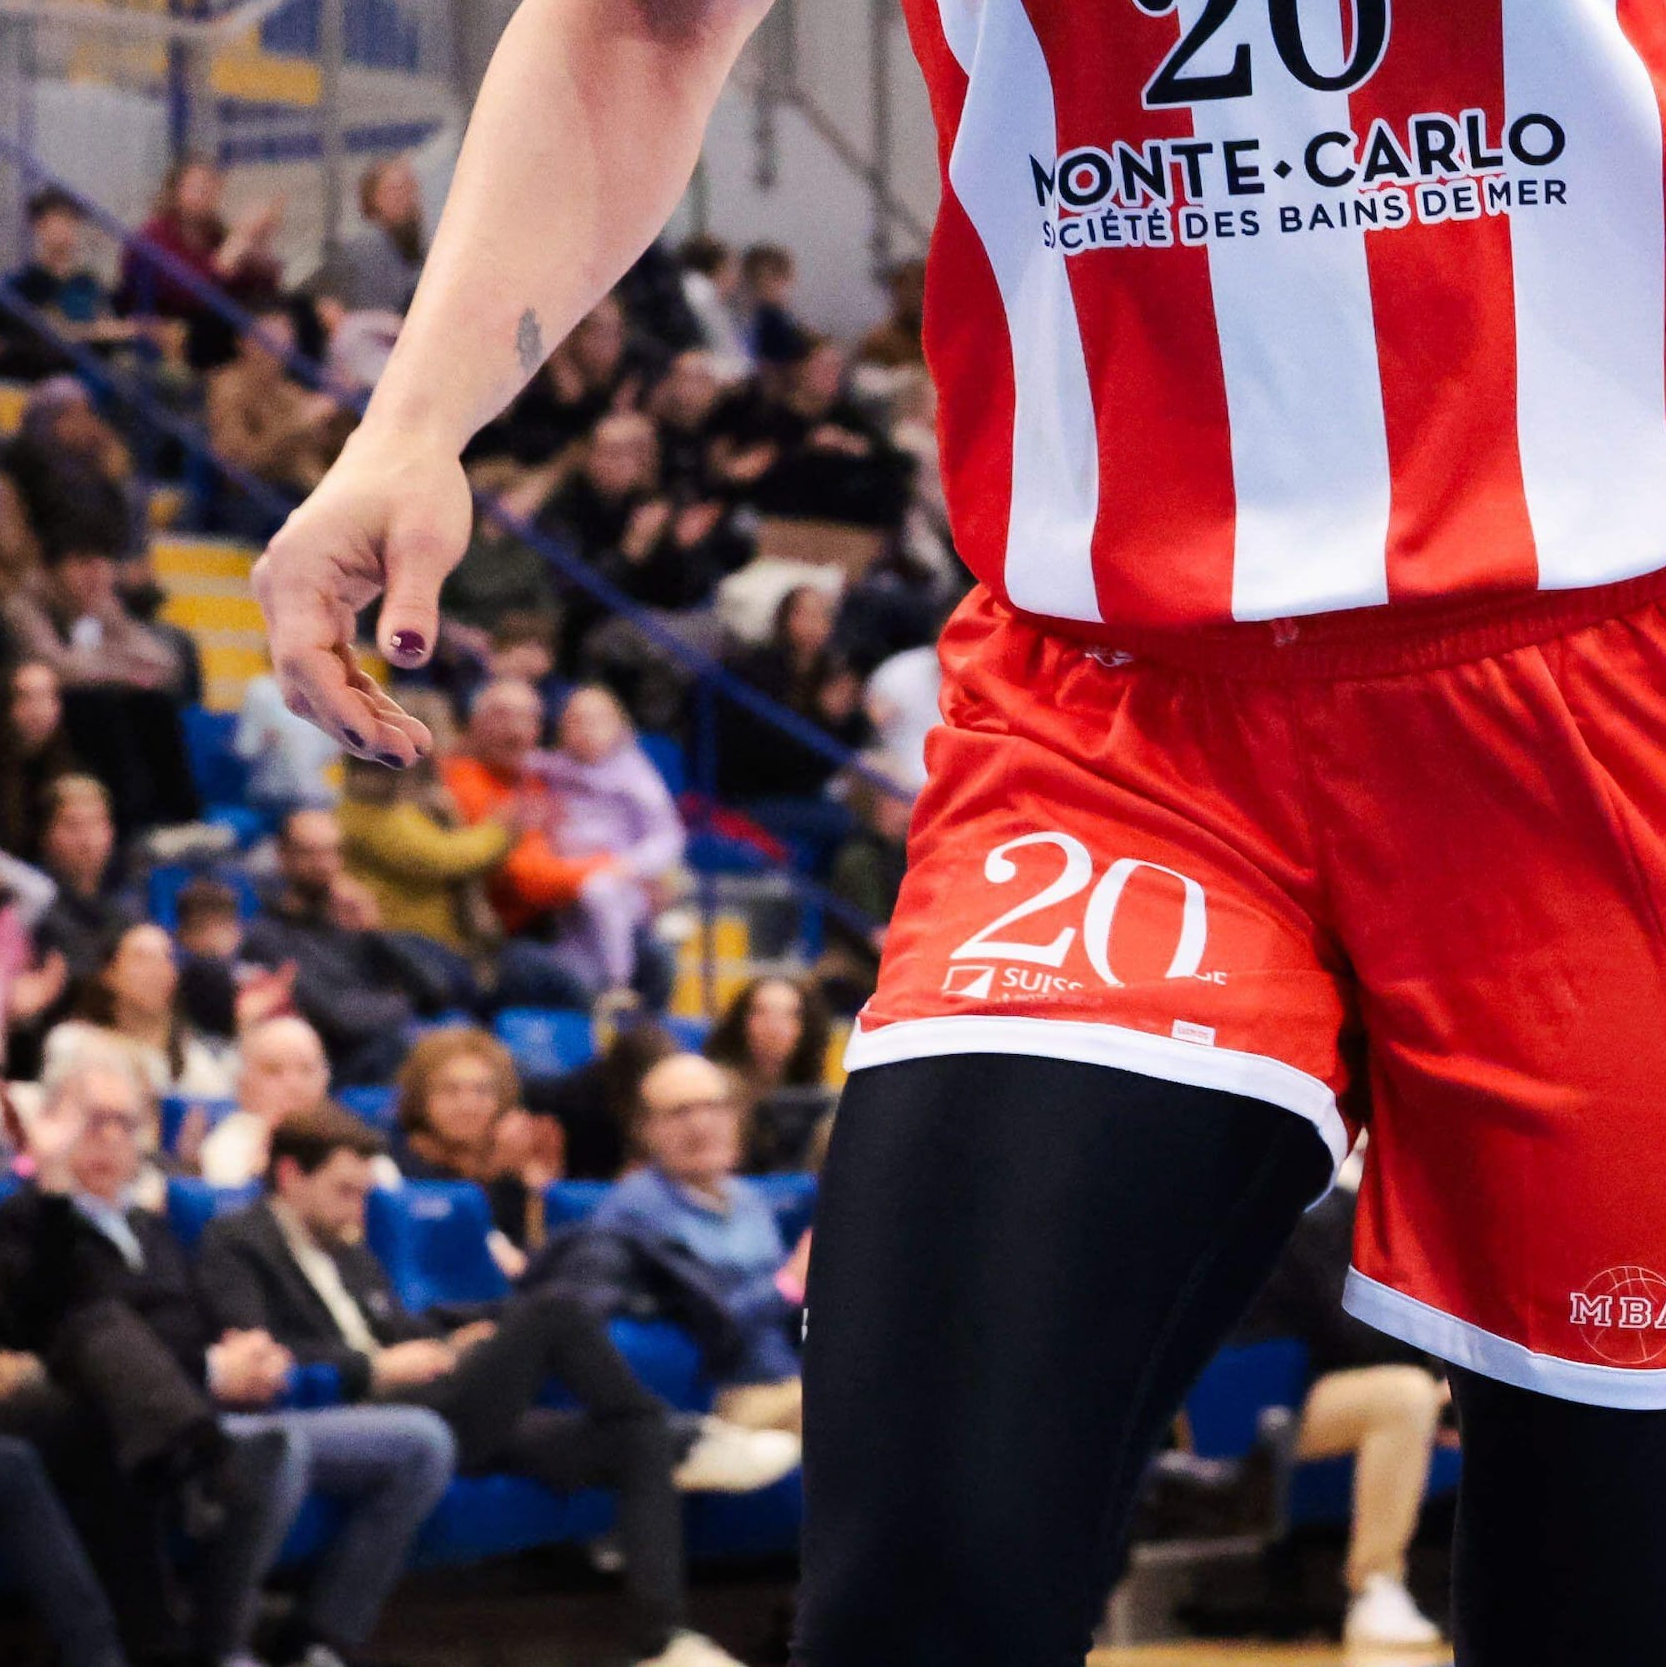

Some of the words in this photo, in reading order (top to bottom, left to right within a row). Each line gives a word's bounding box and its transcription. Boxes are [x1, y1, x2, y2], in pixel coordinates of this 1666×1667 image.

[1185, 209, 1260, 240] DES
[1280, 194, 1405, 233] BAINS
[1422, 185, 1475, 218] DE
[1488, 178, 1568, 210] MER
[950, 830, 1210, 989] 20
